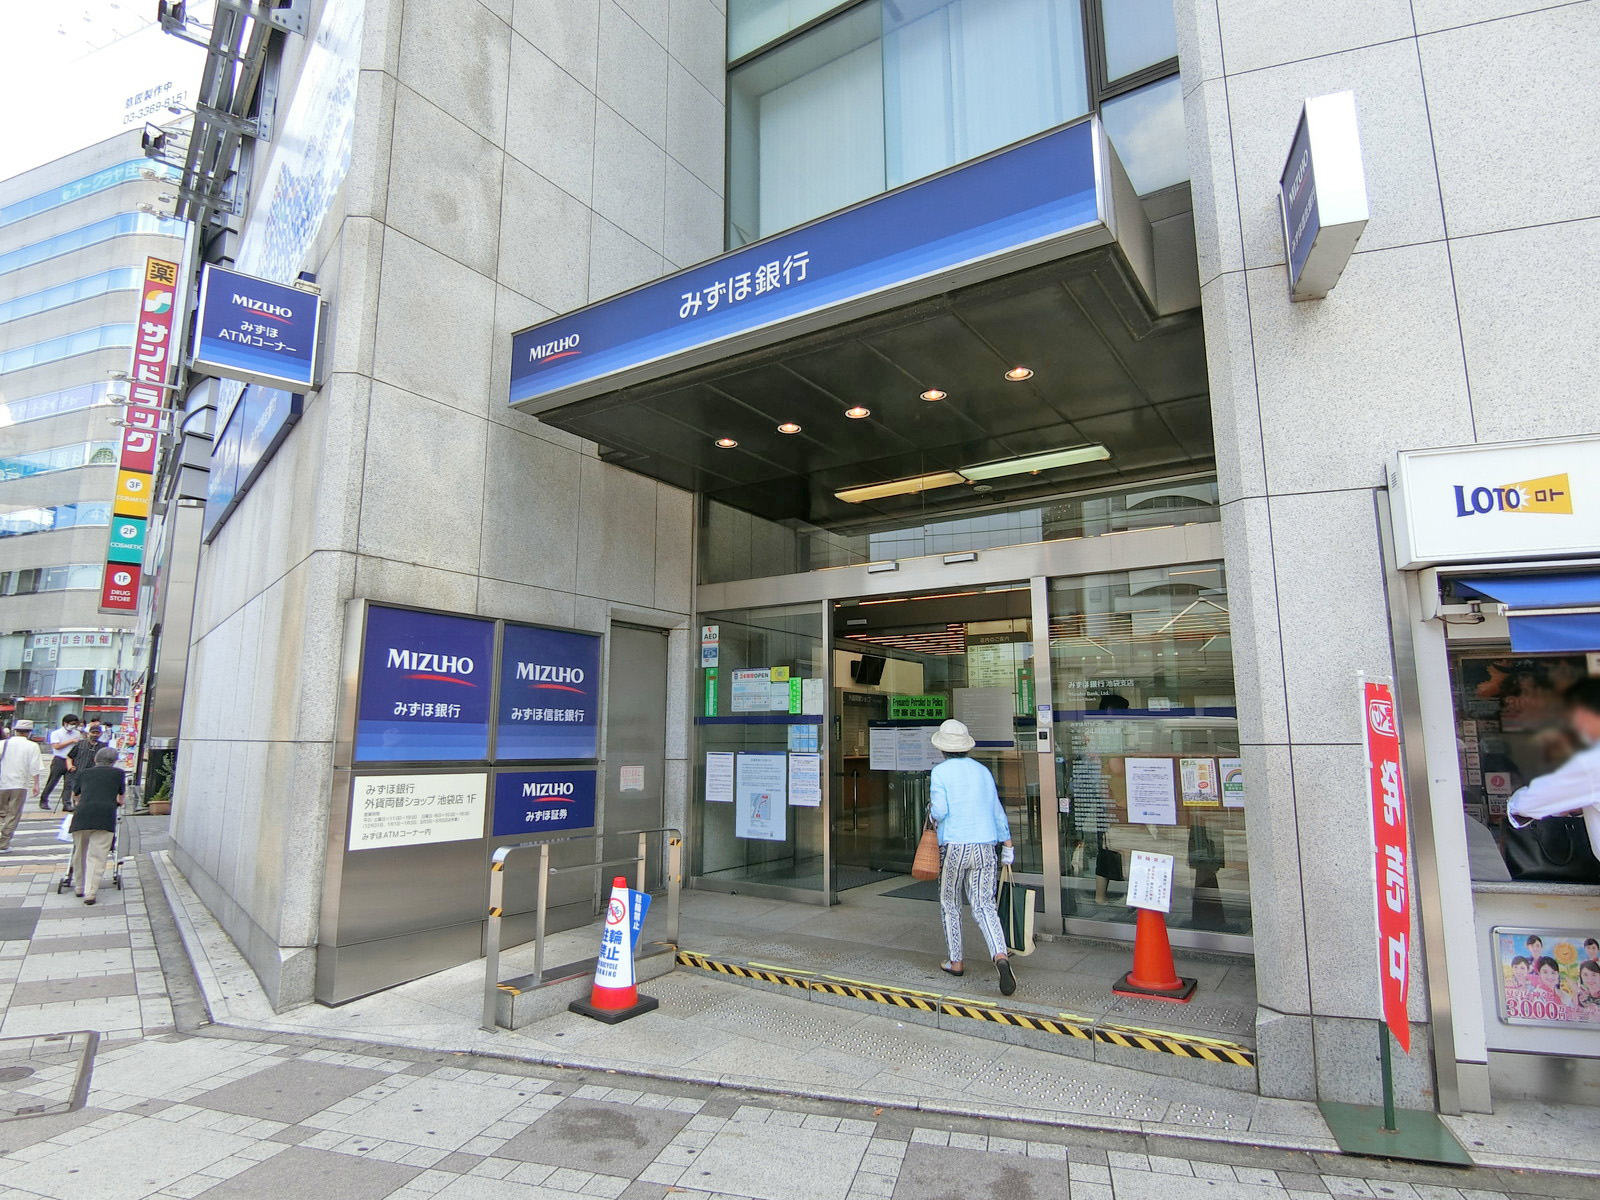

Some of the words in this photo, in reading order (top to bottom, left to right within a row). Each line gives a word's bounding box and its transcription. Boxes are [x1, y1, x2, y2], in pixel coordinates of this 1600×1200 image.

[1288, 149, 1310, 211] MIZUHO
[150, 262, 175, 285] 薬
[679, 250, 810, 318] みずほ銀行
[231, 293, 293, 319] MIZUHO
[240, 320, 279, 338] みずほ
[218, 327, 297, 352] ATMコーナー
[529, 333, 580, 362] MIZUHO
[126, 321, 169, 453] サンドラッグ
[129, 480, 142, 490] 3F
[116, 494, 149, 504] COSMETIC
[1453, 484, 1520, 517] LOTO
[1535, 488, 1564, 502] ロト
[123, 528, 135, 536] 2F
[110, 541, 144, 550] COSMETIC
[117, 575, 129, 583] 1F
[109, 595, 131, 603] STORE
[111, 588, 131, 596] DRUG
[704, 633, 718, 641] AED
[387, 648, 474, 675] MIZUHO
[516, 661, 585, 684] MIZUHO
[393, 702, 461, 719] みずほ銀行
[511, 707, 585, 722] みずほ信託銀行
[365, 783, 416, 796] みずほ銀行
[522, 783, 575, 797] MIZUHO
[364, 796, 436, 810] 外貨両替ショップ
[437, 795, 464, 806] 池袋店
[467, 794, 478, 804] 1F
[525, 808, 568, 822] みずほ証券
[362, 828, 432, 841] みずほATMコーナー内
